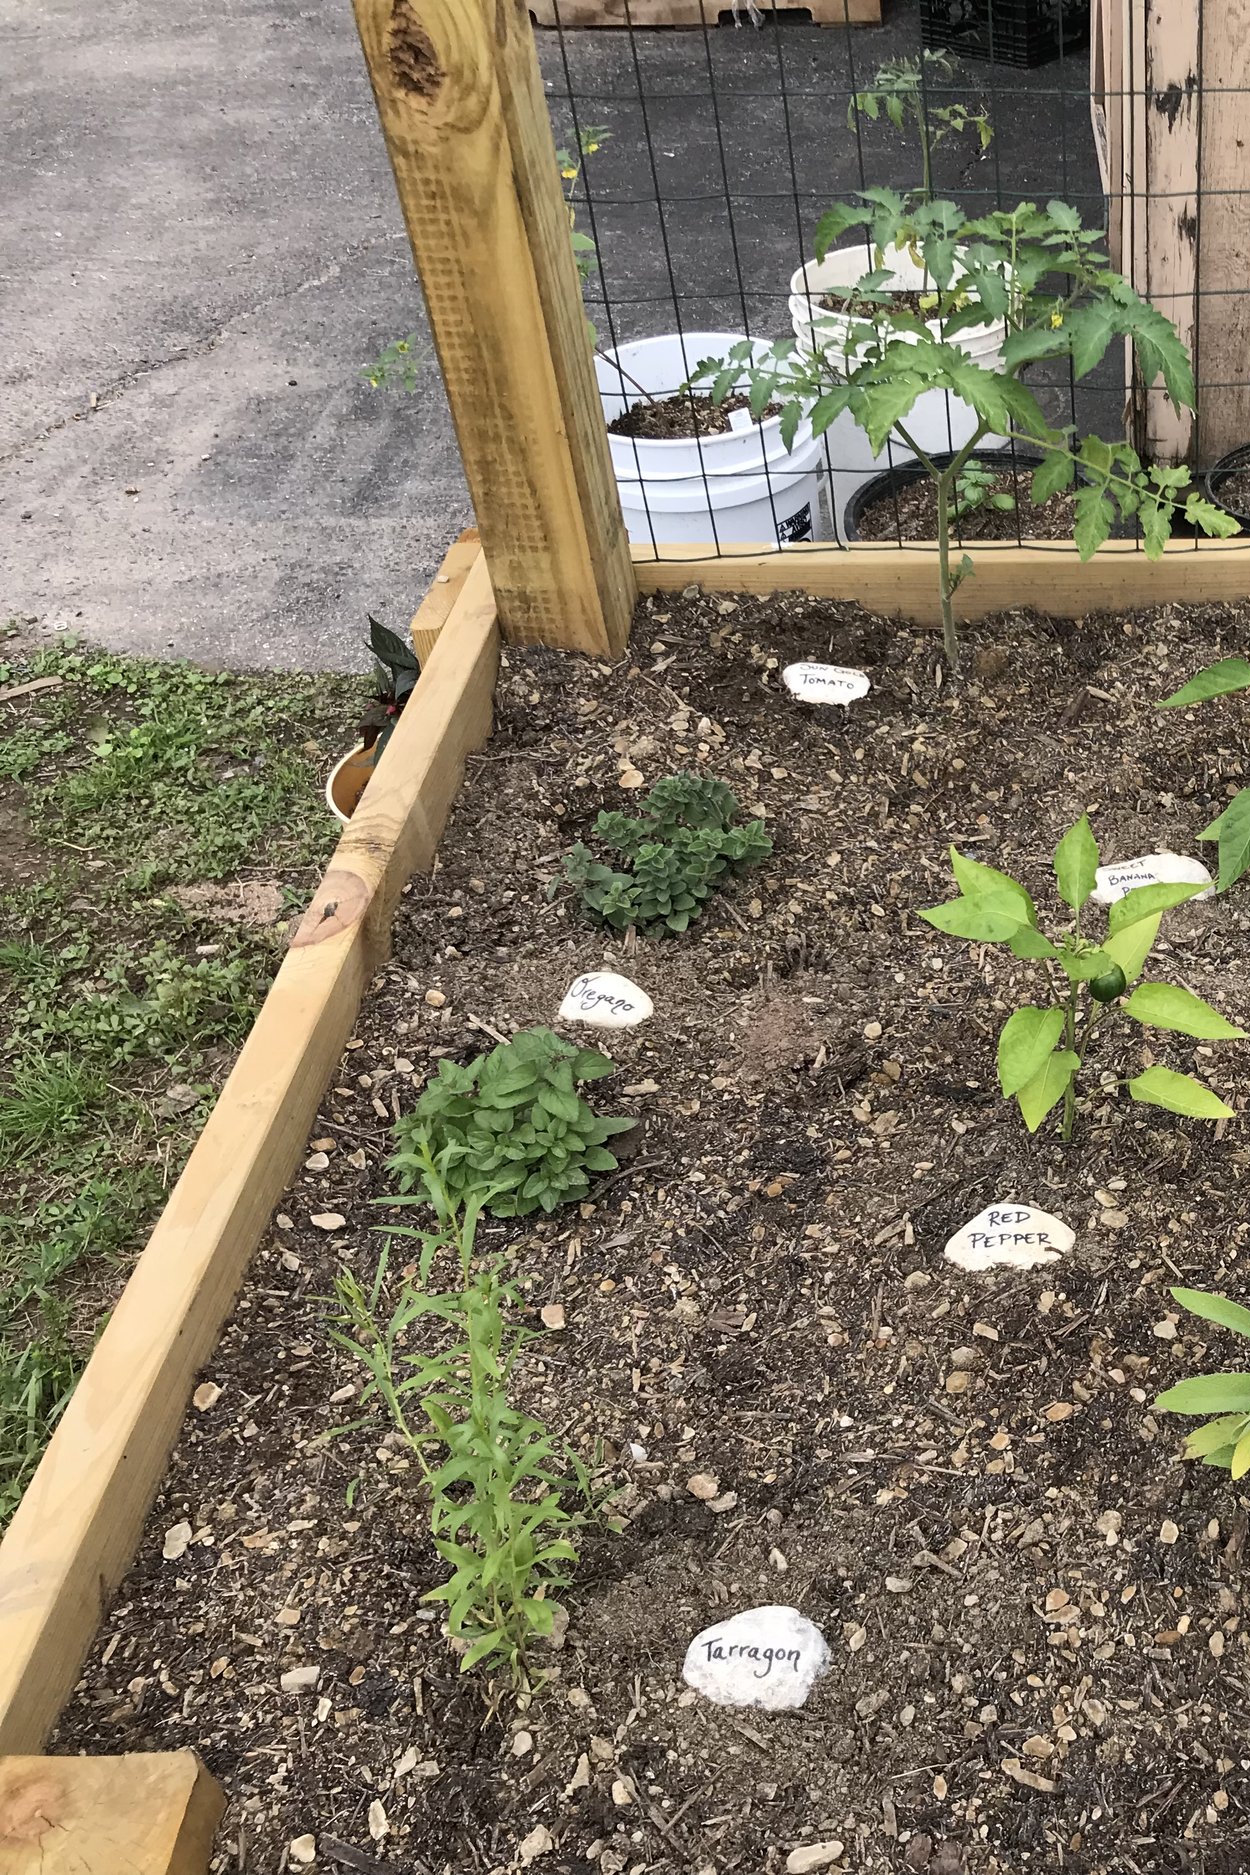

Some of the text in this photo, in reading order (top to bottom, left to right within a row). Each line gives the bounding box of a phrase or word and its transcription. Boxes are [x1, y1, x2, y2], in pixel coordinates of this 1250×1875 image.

[799, 673, 855, 689] TOMATO
[1108, 872, 1156, 887] BANANA
[571, 975, 636, 1016] Oregano
[988, 1211, 1031, 1227] RED
[967, 1232, 1052, 1249] PEPPER
[700, 1637, 801, 1679] Tarragon
